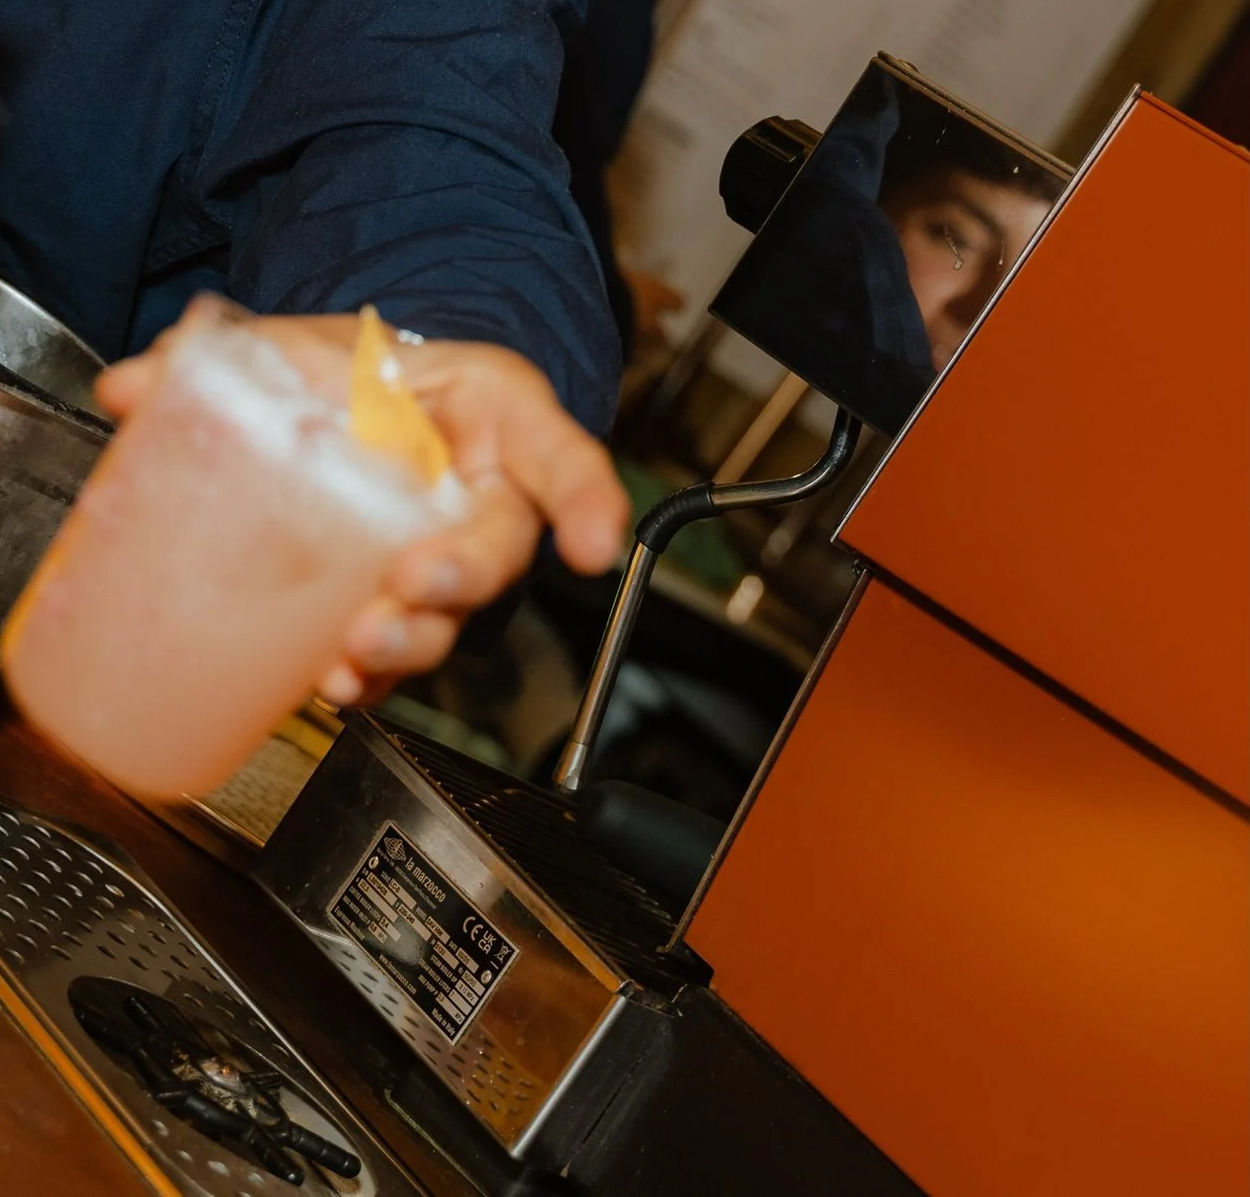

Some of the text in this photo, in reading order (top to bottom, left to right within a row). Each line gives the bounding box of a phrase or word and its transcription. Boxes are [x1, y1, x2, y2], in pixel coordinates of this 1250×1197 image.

[405, 858, 446, 903] la marzocco
[477, 938, 492, 954] CA
[483, 930, 496, 947] UK
[432, 1008, 444, 1023] Made
